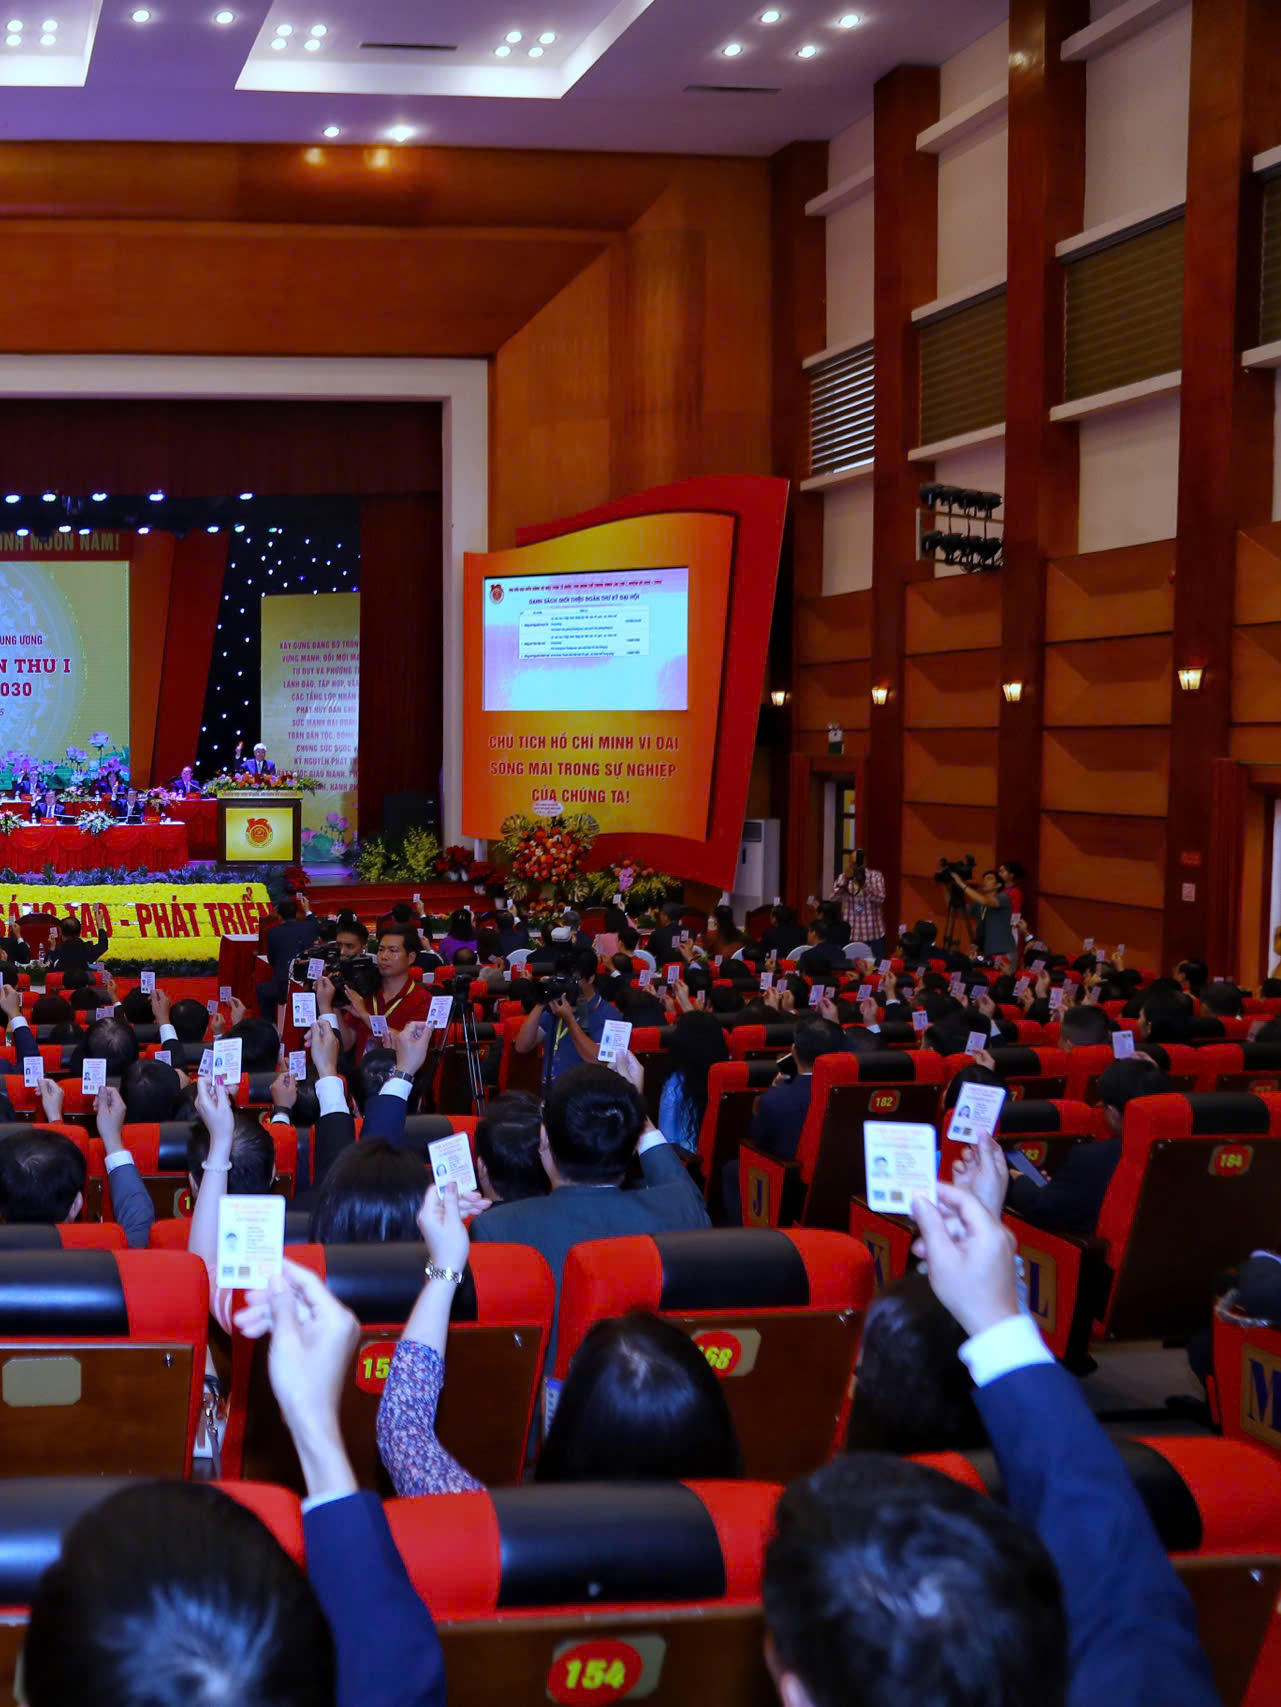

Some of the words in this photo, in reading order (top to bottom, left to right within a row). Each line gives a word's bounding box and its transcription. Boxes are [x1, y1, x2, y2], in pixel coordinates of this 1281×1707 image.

[19, 634, 43, 646] ƯƠNG
[13, 653, 58, 673] THỨ
[63, 658, 71, 673] I
[488, 732, 514, 749] CHỦ
[518, 734, 547, 752] TỊCH
[550, 732, 568, 750] HỒ
[571, 732, 595, 750] CHÍ
[598, 735, 634, 751] MINH
[655, 735, 680, 752] ĐẠI
[489, 756, 524, 776] SỐNG
[527, 759, 553, 776] MÃI
[557, 762, 600, 777] TRONG
[604, 762, 624, 780] SỰ
[626, 763, 677, 781] NGHIỆP
[531, 784, 557, 802] CỦA
[561, 785, 606, 804] CHÚNG
[609, 789, 631, 804] TA!
[134, 895, 201, 938] PHÁT
[875, 1096, 894, 1107] 182
[362, 1357, 391, 1379] 15
[699, 1345, 733, 1370] 68
[565, 1658, 626, 1689] 154
